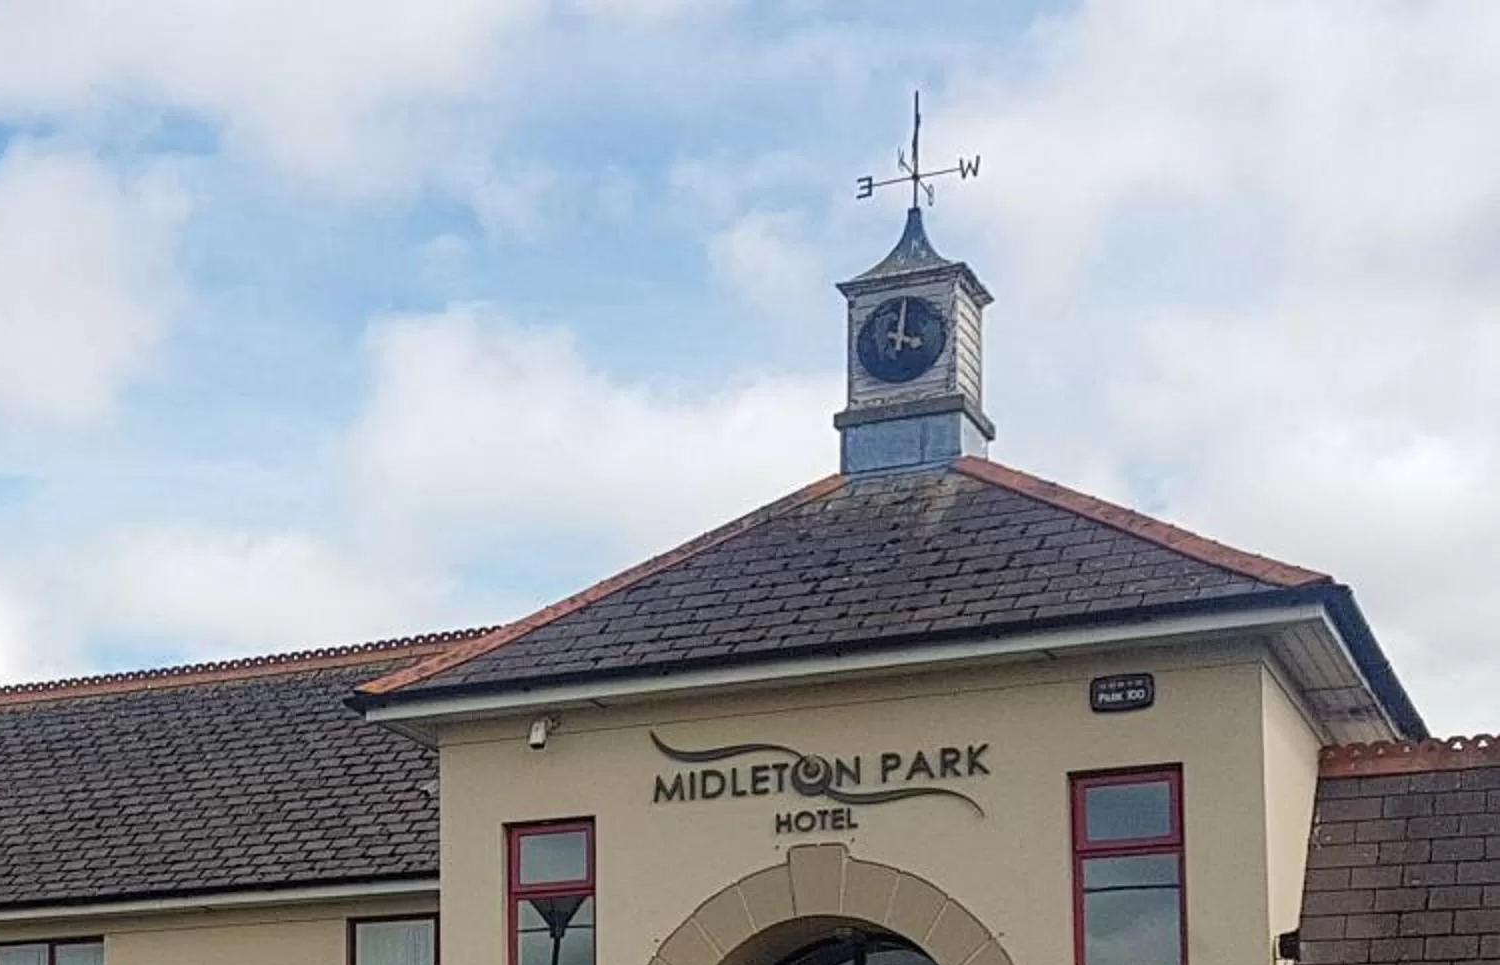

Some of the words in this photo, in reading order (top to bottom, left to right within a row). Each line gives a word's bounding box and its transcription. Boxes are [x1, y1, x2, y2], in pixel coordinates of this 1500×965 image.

[653, 754, 861, 803] MIDLETON
[881, 743, 991, 782] PARK
[775, 808, 858, 834] HOTEL
